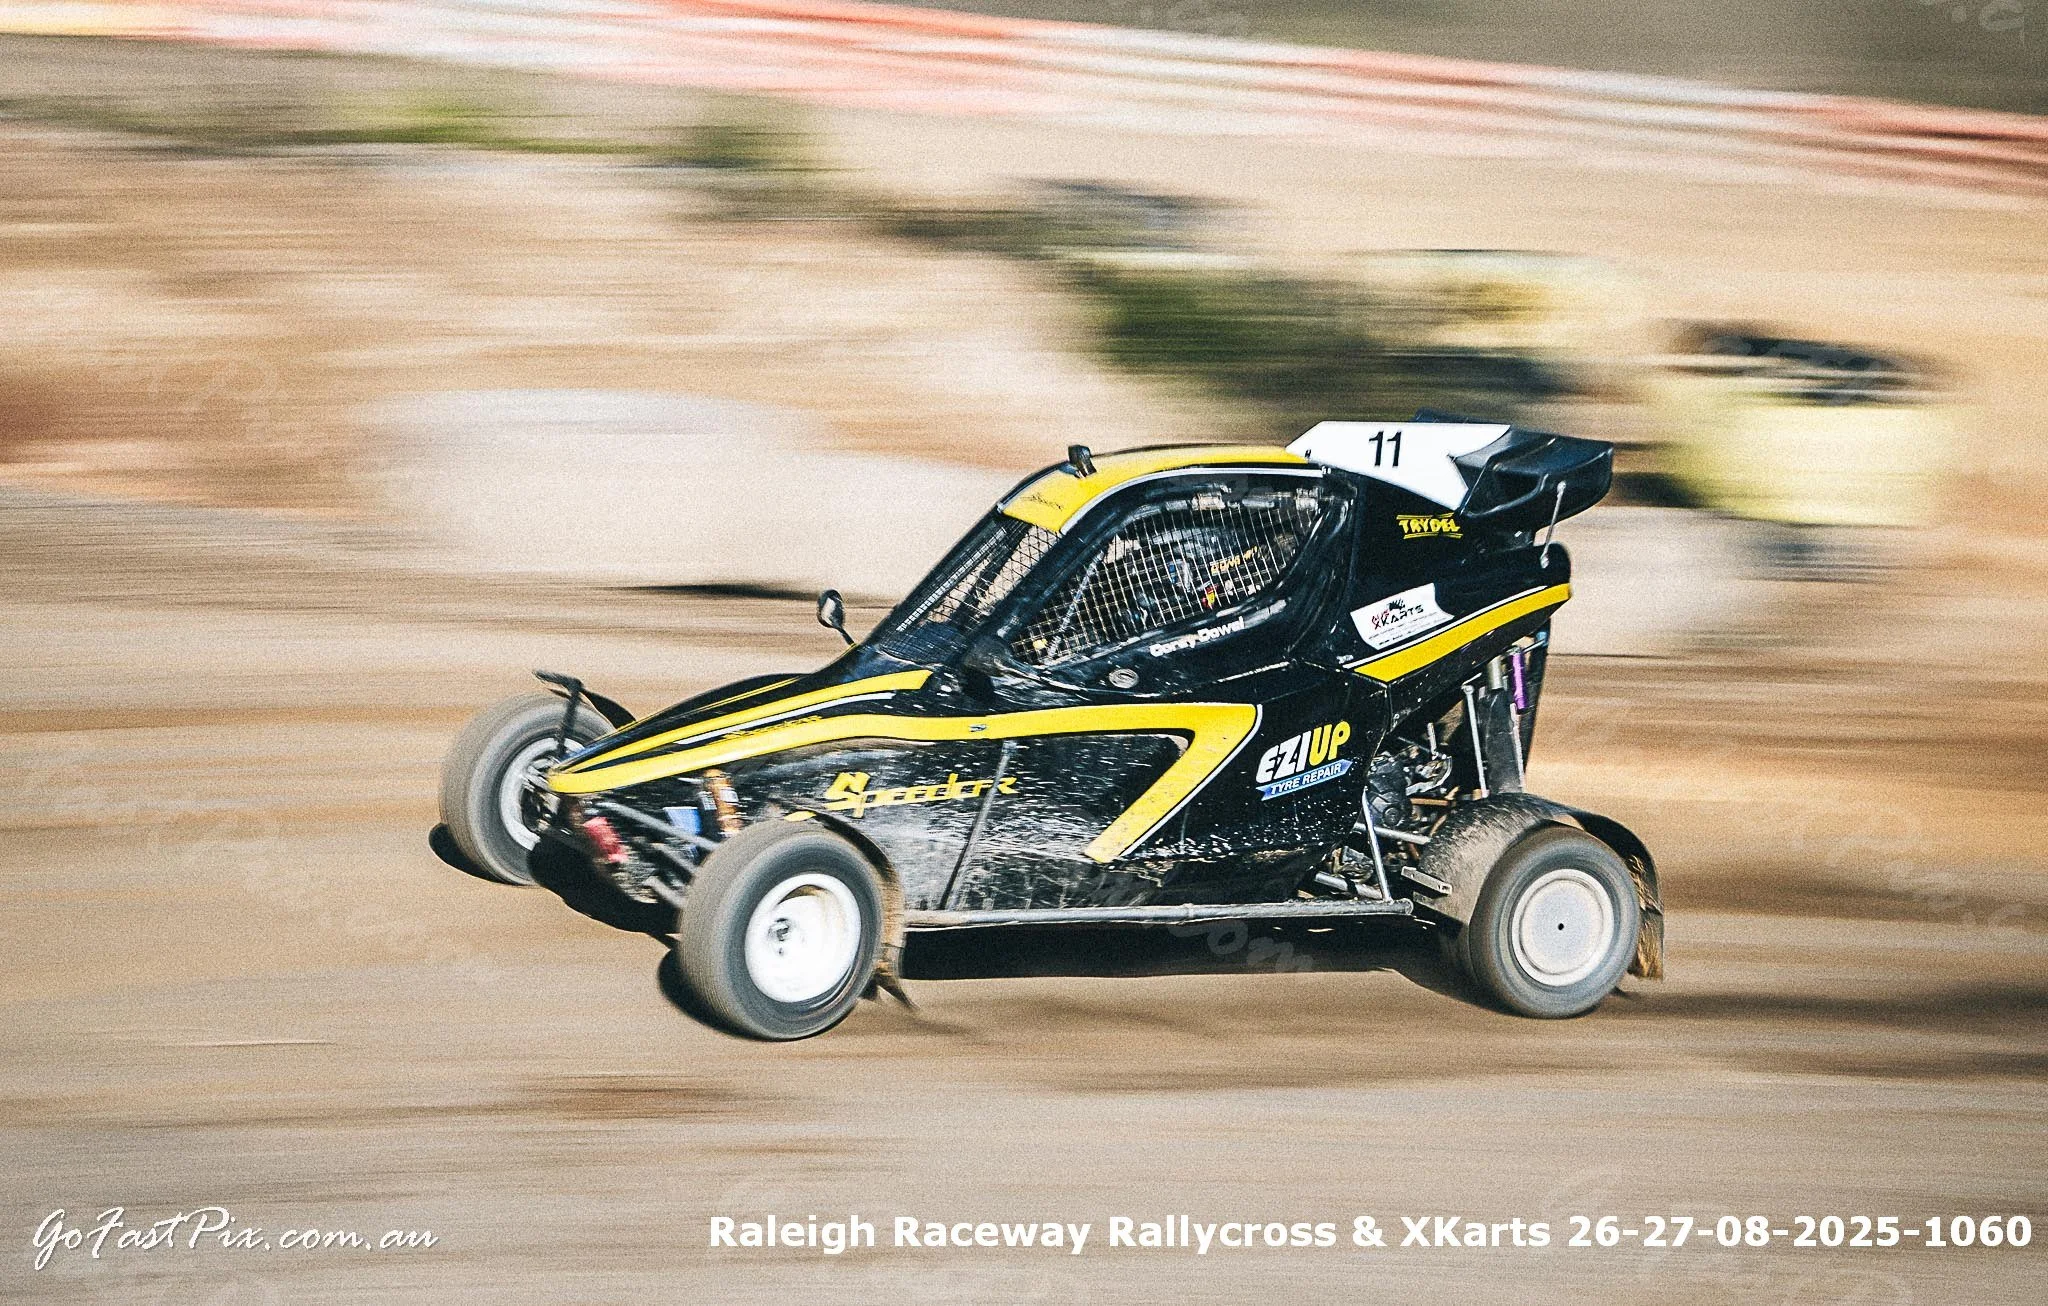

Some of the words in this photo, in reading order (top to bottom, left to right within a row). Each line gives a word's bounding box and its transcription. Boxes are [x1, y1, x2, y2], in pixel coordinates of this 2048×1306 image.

[1368, 430, 1402, 467] 11
[1270, 777, 1301, 795] TYRE
[1301, 763, 1342, 785] REPAIR
